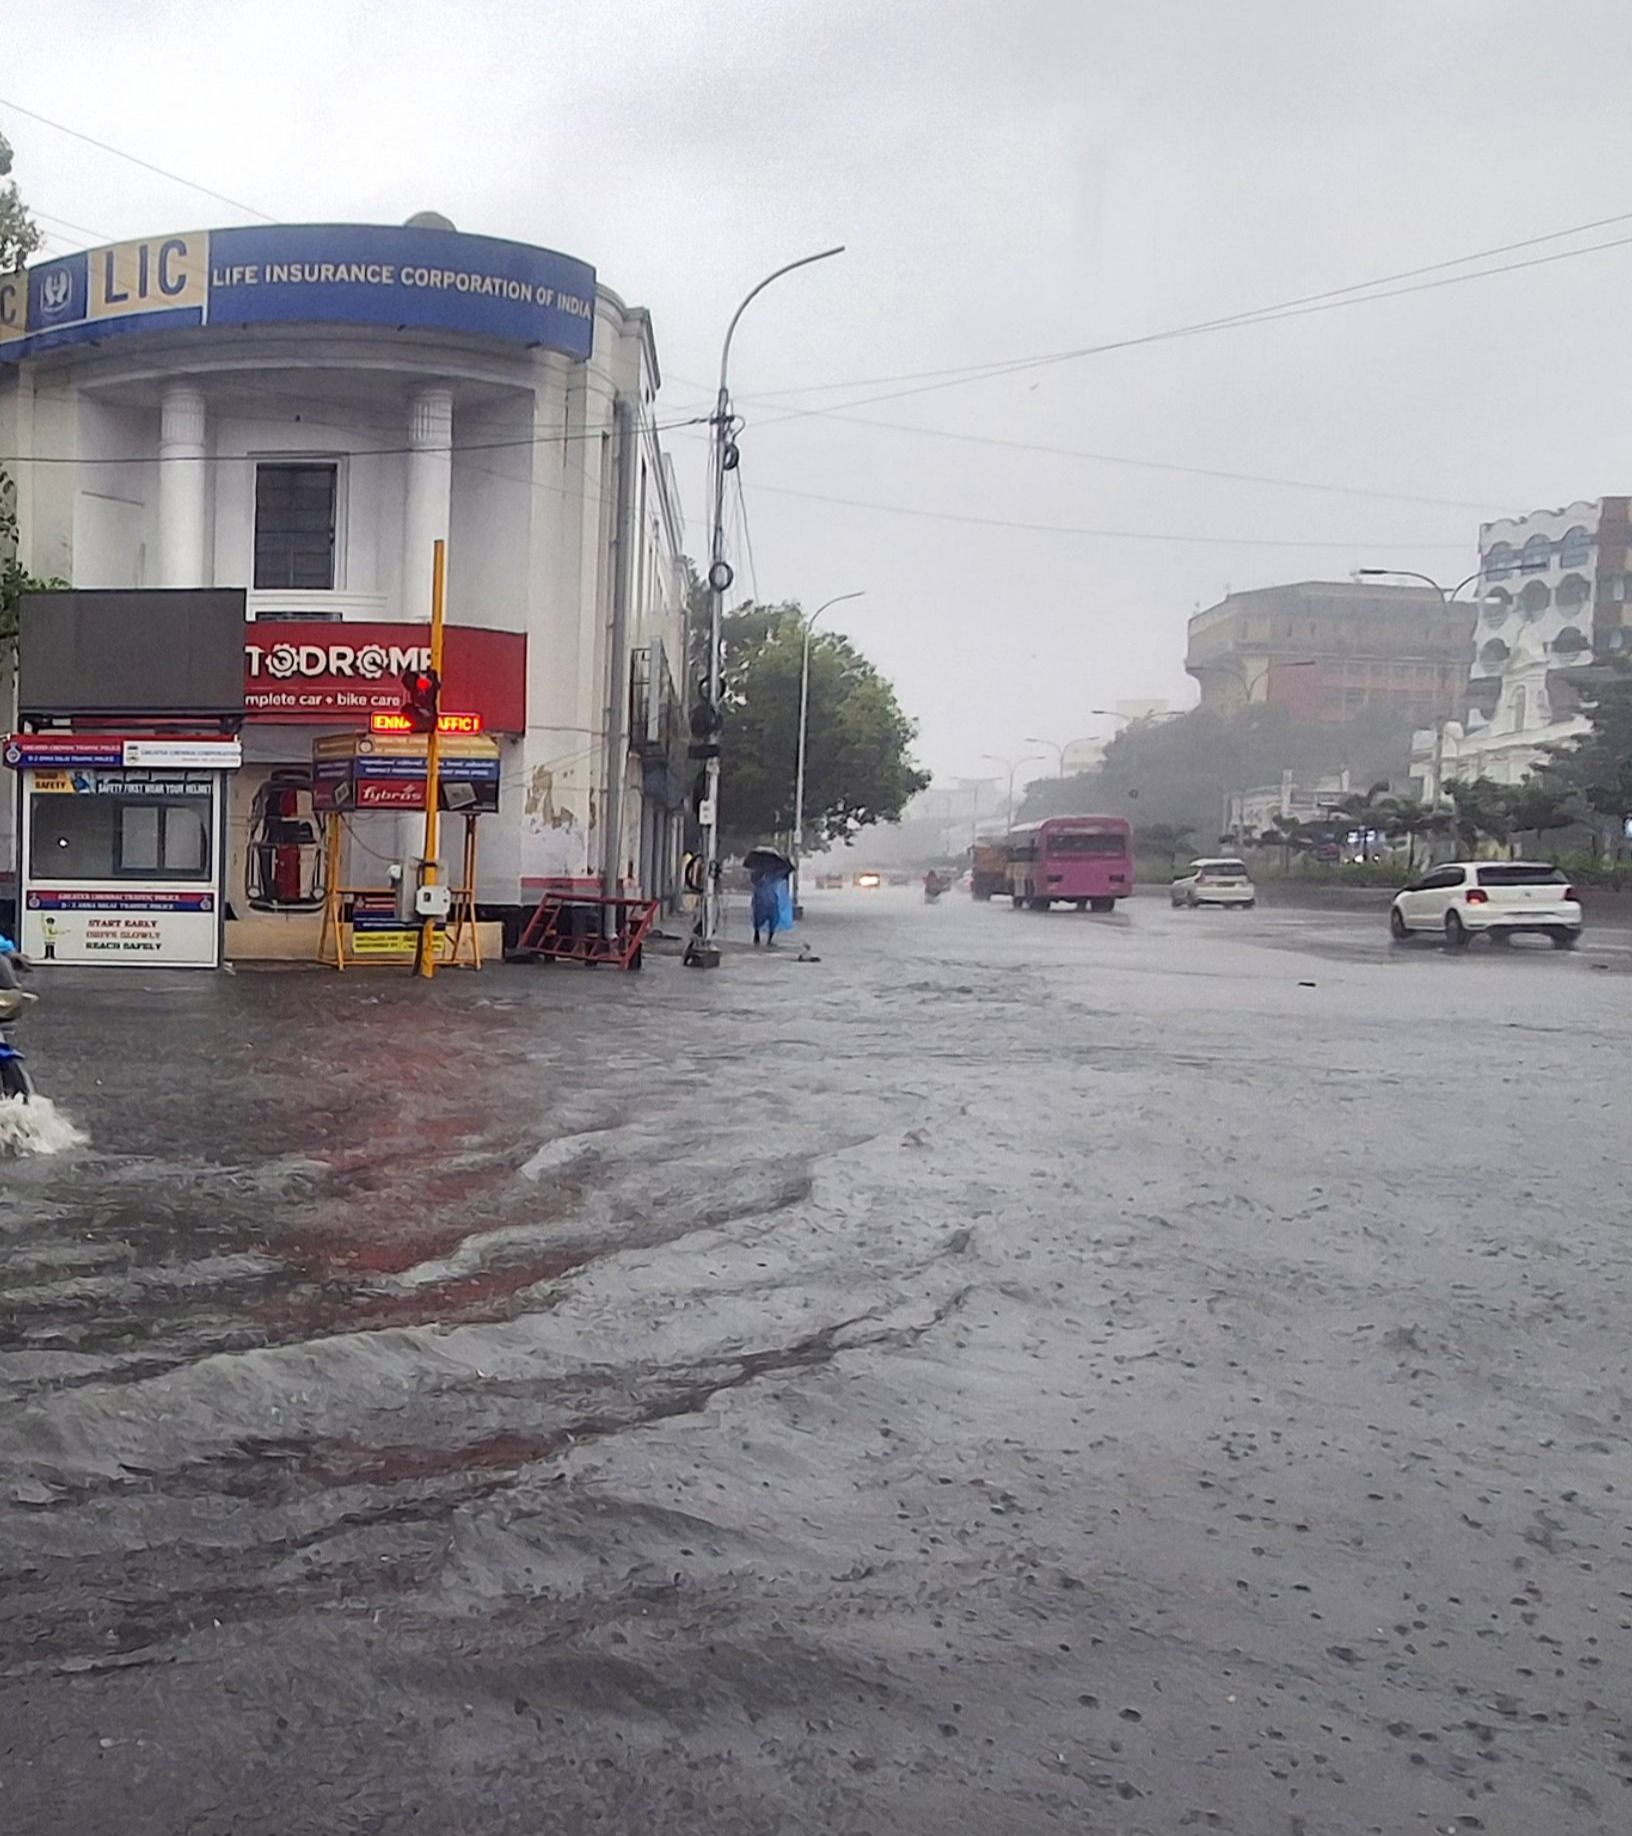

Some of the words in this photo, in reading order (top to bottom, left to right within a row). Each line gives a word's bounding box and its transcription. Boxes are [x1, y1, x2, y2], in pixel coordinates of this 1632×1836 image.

[104, 239, 188, 304] LIC
[212, 265, 258, 287] LIFE
[266, 263, 394, 285] INSURANCE
[400, 266, 532, 302] CORPORATION
[536, 286, 554, 307] OF
[557, 292, 592, 320] INDIA
[299, 694, 322, 706] car
[337, 692, 367, 706] bike
[370, 694, 401, 707] care
[88, 919, 121, 928] START
[125, 920, 158, 928] EARLY
[120, 931, 161, 939] SLOWLY
[85, 942, 120, 950] REACH
[123, 942, 162, 950] SAFELY
